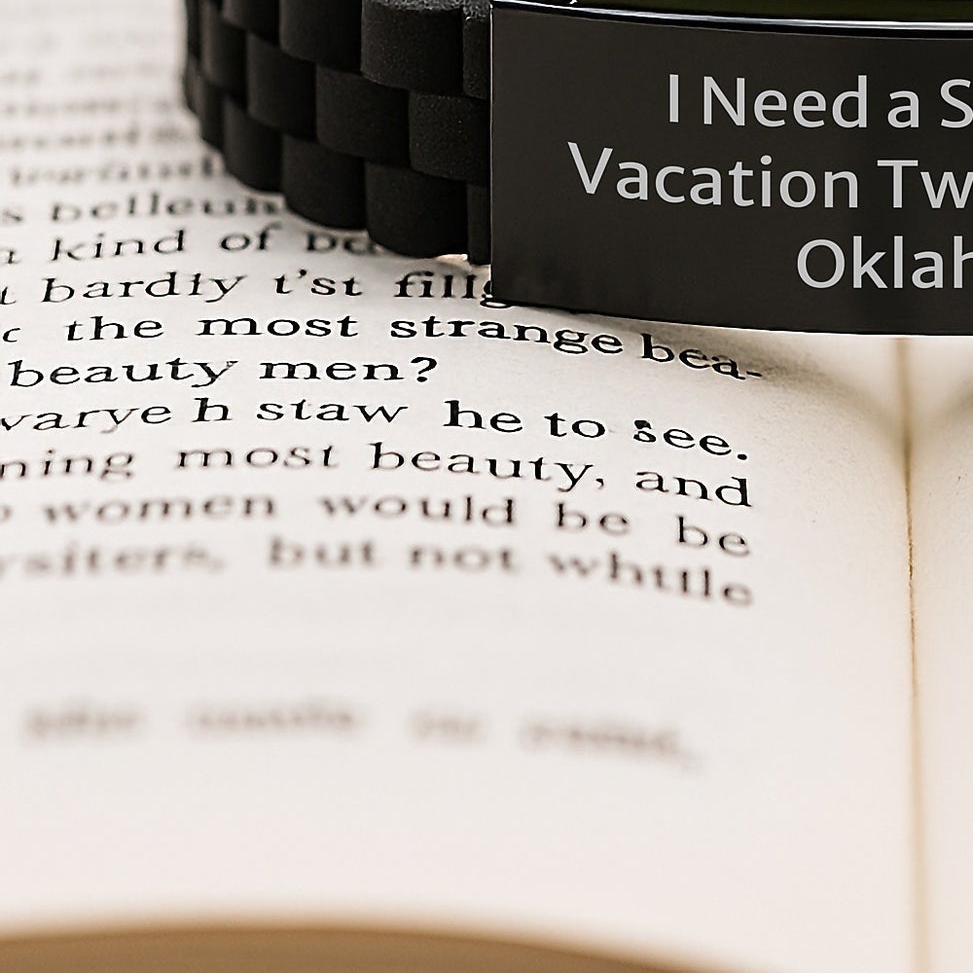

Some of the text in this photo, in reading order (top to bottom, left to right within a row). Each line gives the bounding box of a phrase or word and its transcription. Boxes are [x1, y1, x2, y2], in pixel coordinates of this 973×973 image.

[668, 75, 680, 125] I
[703, 74, 869, 129] Need
[888, 87, 920, 129] a
[567, 141, 858, 209] Vacation
[52, 230, 186, 263] kind
[8, 356, 438, 388] beauty men?
[66, 316, 164, 341] the
[197, 316, 359, 340] most
[390, 315, 624, 354] strange
[641, 333, 763, 380] bea-
[194, 398, 232, 422] h
[256, 398, 409, 424] staw
[443, 400, 524, 433] he
[544, 412, 607, 438] to
[632, 419, 748, 461] see.
[176, 444, 338, 469] most
[370, 442, 606, 492] beauty,
[634, 470, 753, 508] and
[44, 494, 277, 524] women
[318, 495, 516, 527] would
[556, 502, 632, 536] be
[677, 516, 751, 557] be
[268, 535, 378, 569] but
[408, 544, 519, 573] not
